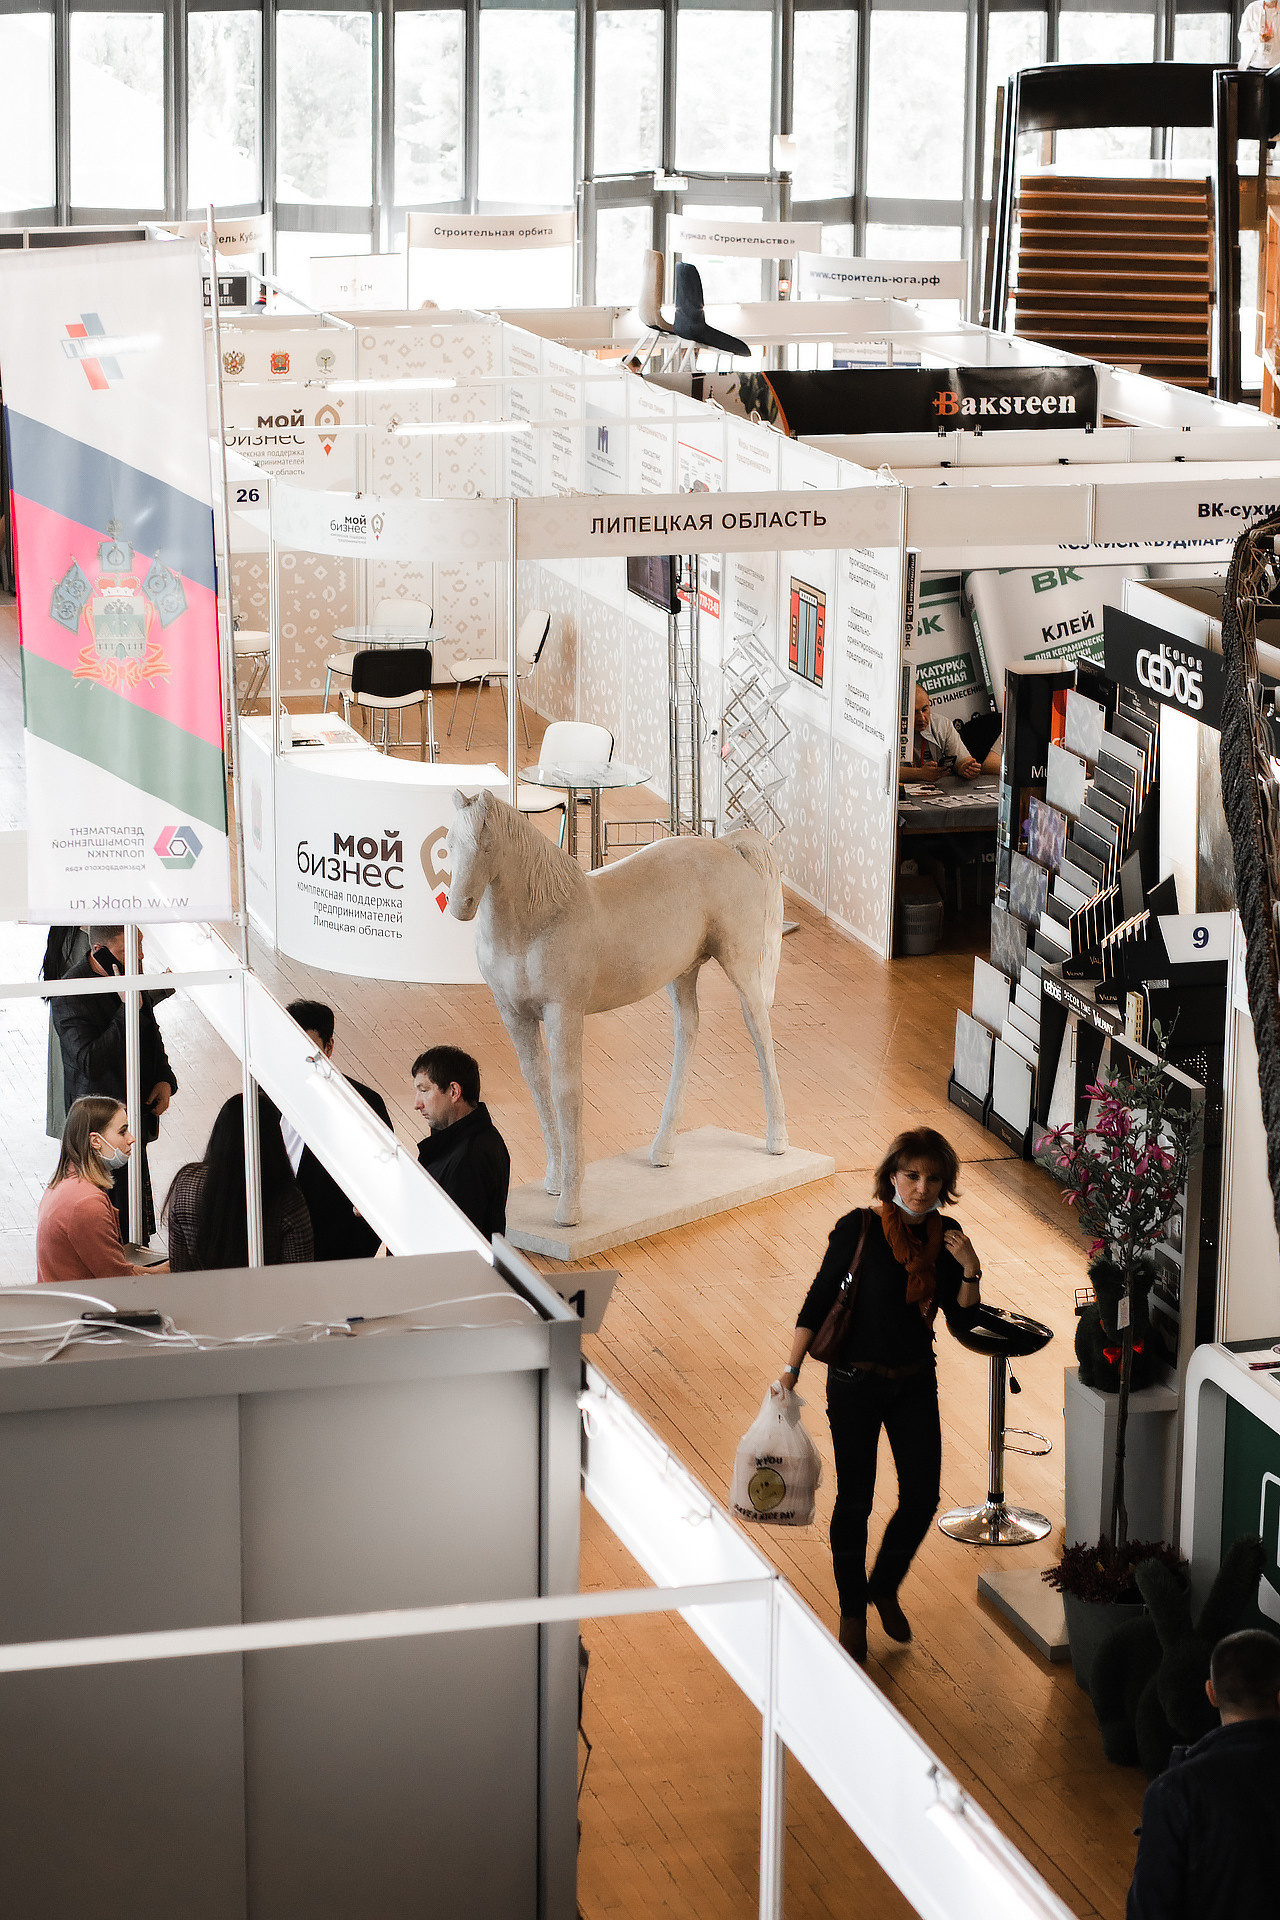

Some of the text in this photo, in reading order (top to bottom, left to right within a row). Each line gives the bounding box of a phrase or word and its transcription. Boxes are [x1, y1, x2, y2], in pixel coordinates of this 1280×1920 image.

[433, 226, 553, 237] Строительная орбита
[708, 233, 796, 245] «Строительство»
[809, 268, 941, 285] www.строитель-юга.рф
[257, 408, 305, 428] мой
[236, 488, 260, 503] 26
[330, 519, 367, 534] бизнес
[344, 514, 367, 526] мой
[590, 510, 827, 535] ЛИПЕЦКАЯ ОБЛАСТЬ
[1042, 610, 1095, 643] КЛЕЙ
[334, 829, 403, 862] мой
[297, 840, 404, 889] бизнес
[297, 881, 403, 909] комплексная поддержка
[314, 901, 403, 923] предпринимателей
[314, 915, 403, 939] Липецкая область
[1192, 926, 1210, 949] 9
